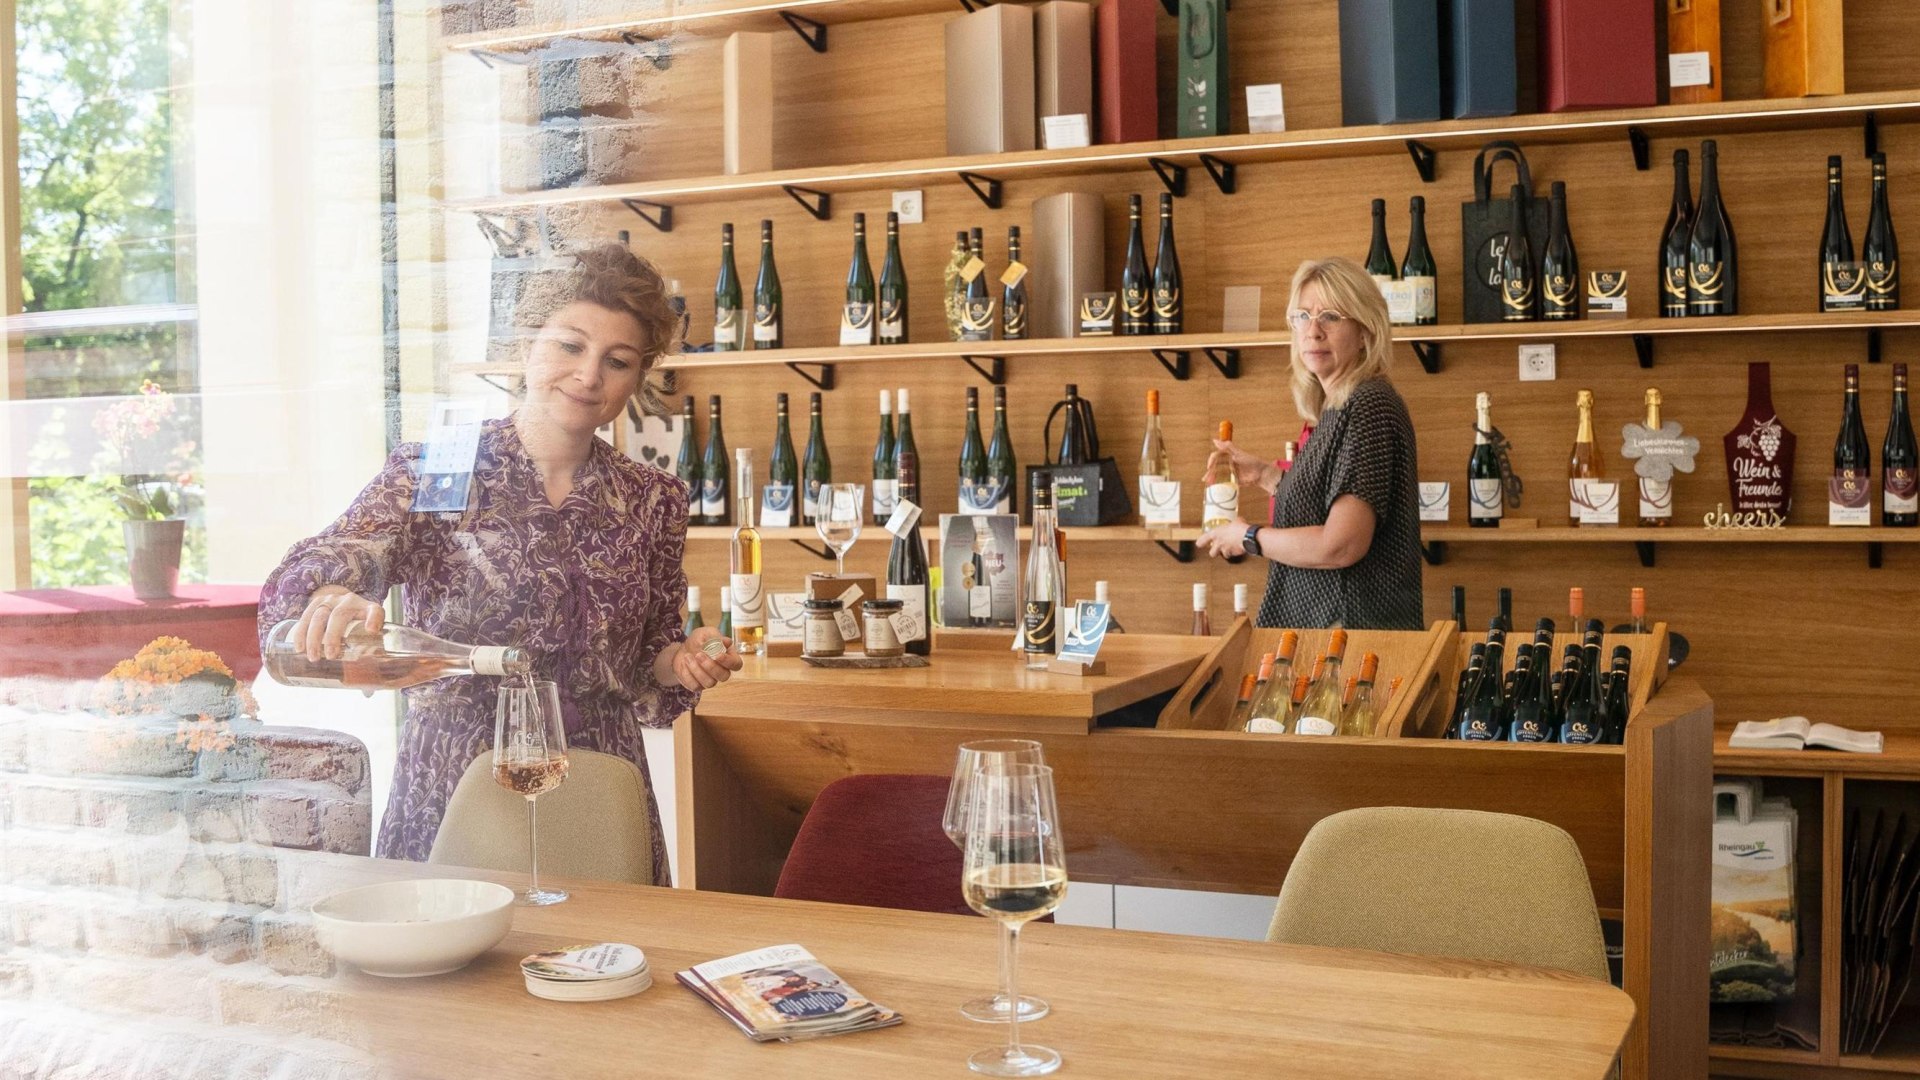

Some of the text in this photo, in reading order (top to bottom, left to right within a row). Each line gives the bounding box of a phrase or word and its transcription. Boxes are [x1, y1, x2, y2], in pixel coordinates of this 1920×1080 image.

[1733, 456, 1782, 479] Wein &
[1703, 502, 1787, 530] cheers
[985, 559, 1002, 568] NEU
[1718, 843, 1756, 852] Rheingau
